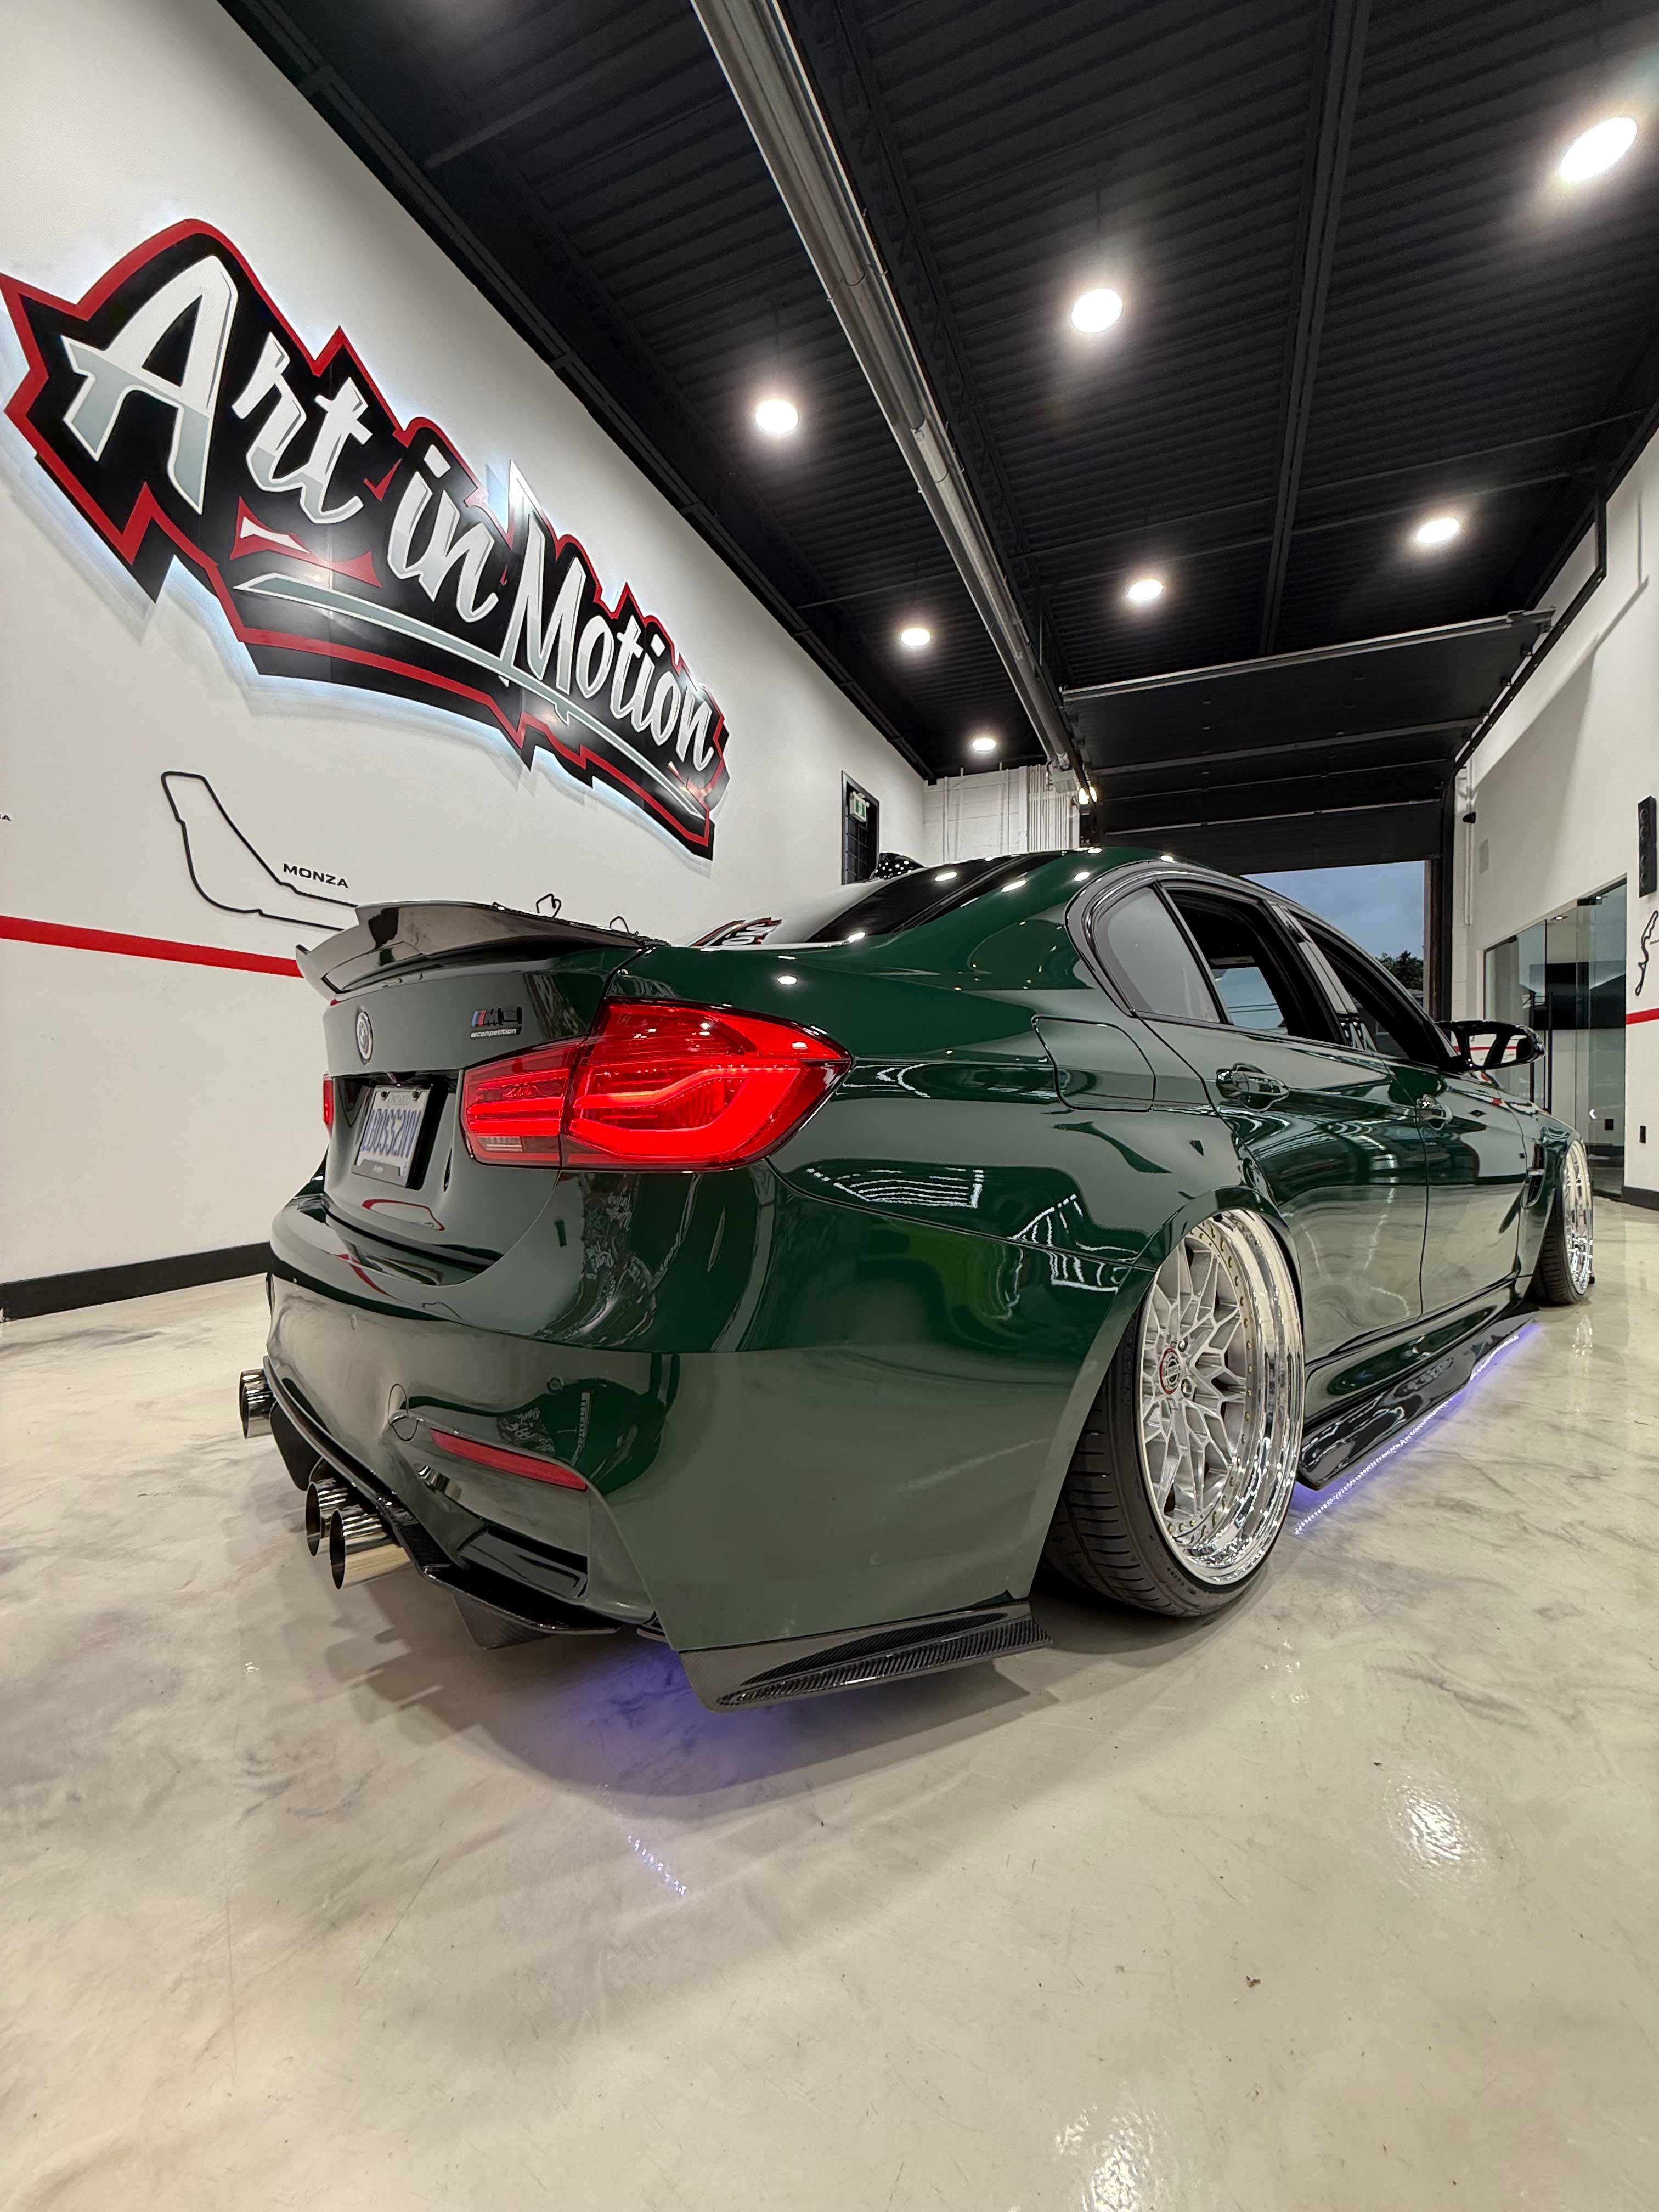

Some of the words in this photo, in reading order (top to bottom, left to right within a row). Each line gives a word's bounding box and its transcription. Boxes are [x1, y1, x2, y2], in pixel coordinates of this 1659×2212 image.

[61, 255, 373, 524] Art
[387, 444, 499, 623] in
[500, 512, 714, 771] Motion
[283, 863, 349, 889] MONZA
